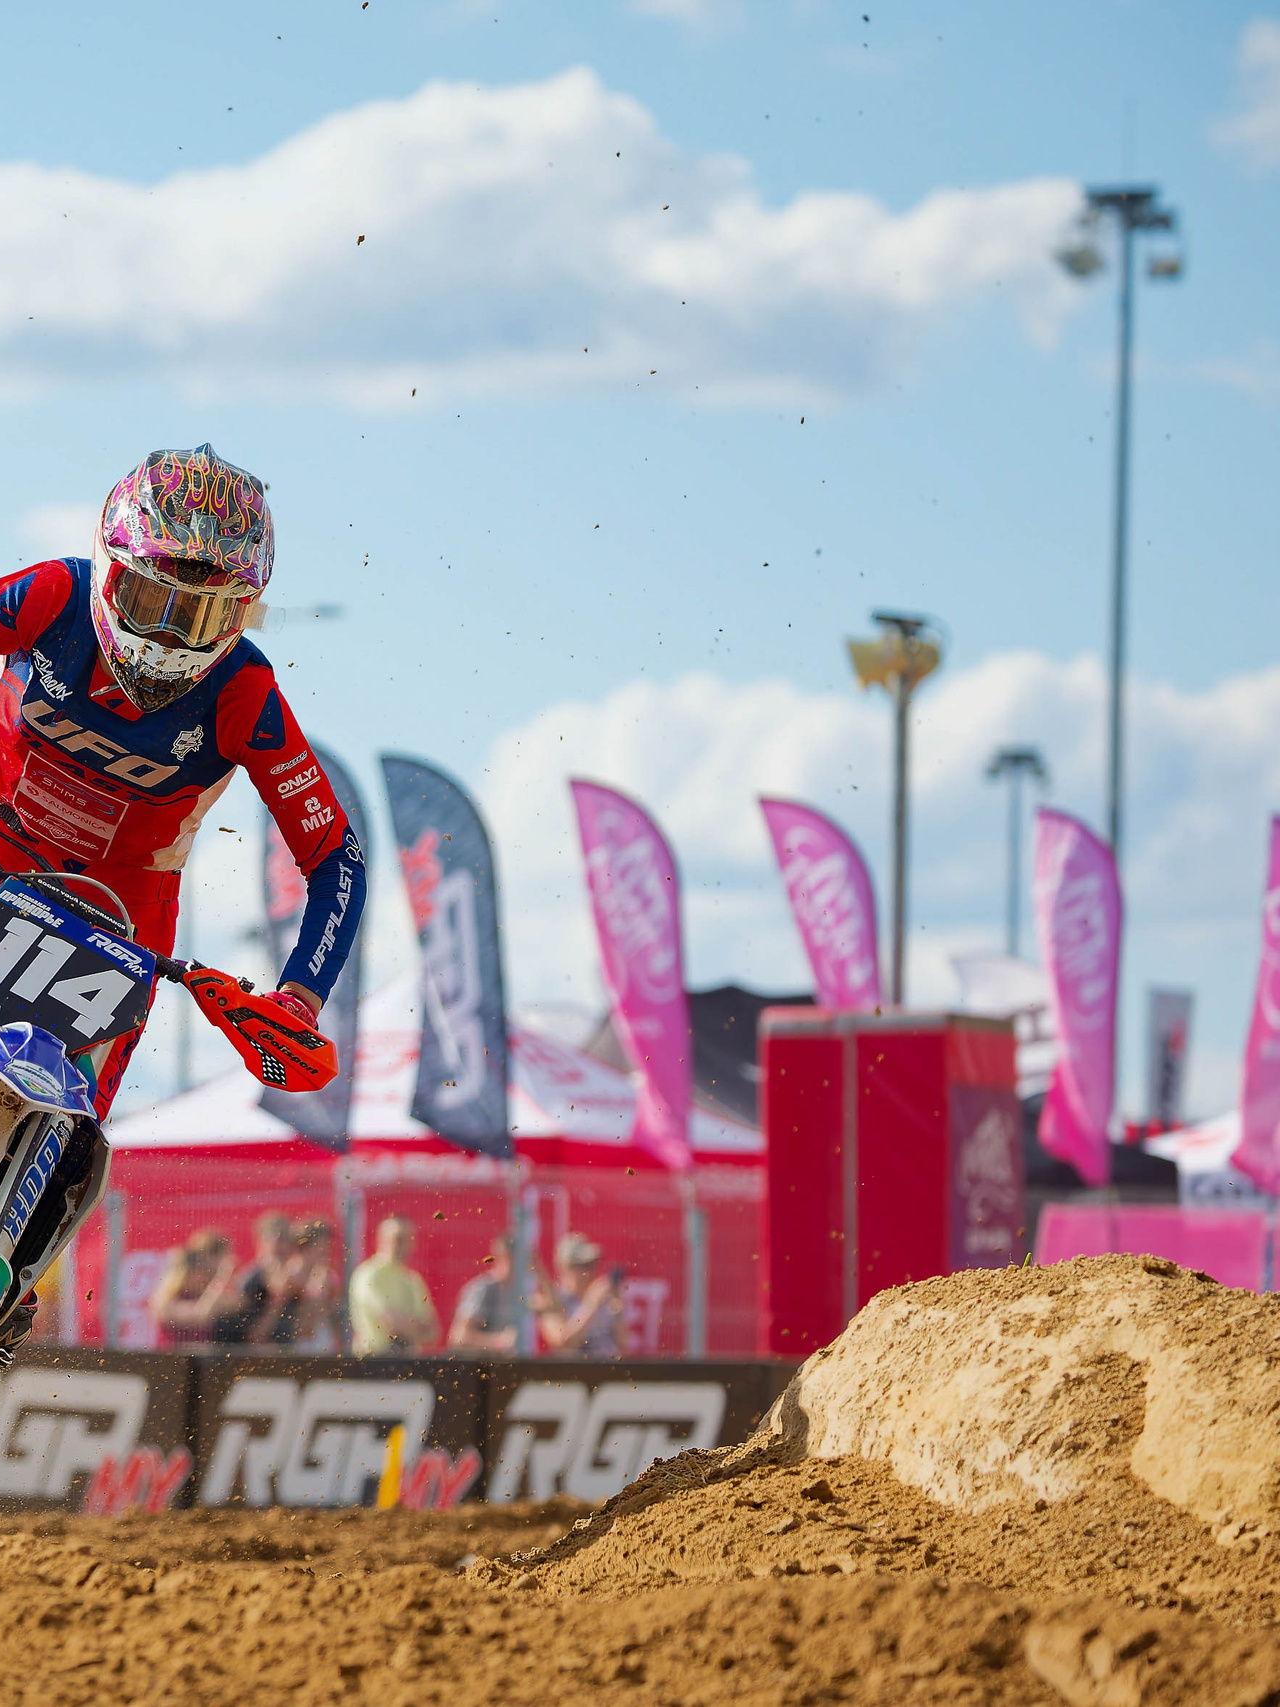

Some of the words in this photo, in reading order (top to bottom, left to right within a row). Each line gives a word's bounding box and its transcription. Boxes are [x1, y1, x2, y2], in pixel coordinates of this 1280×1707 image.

[22, 700, 180, 788] UFO
[42, 796, 107, 832] SALMONICA
[301, 806, 335, 833] MIZ
[200, 1376, 435, 1507] RGP
[486, 1379, 727, 1505] RGP
